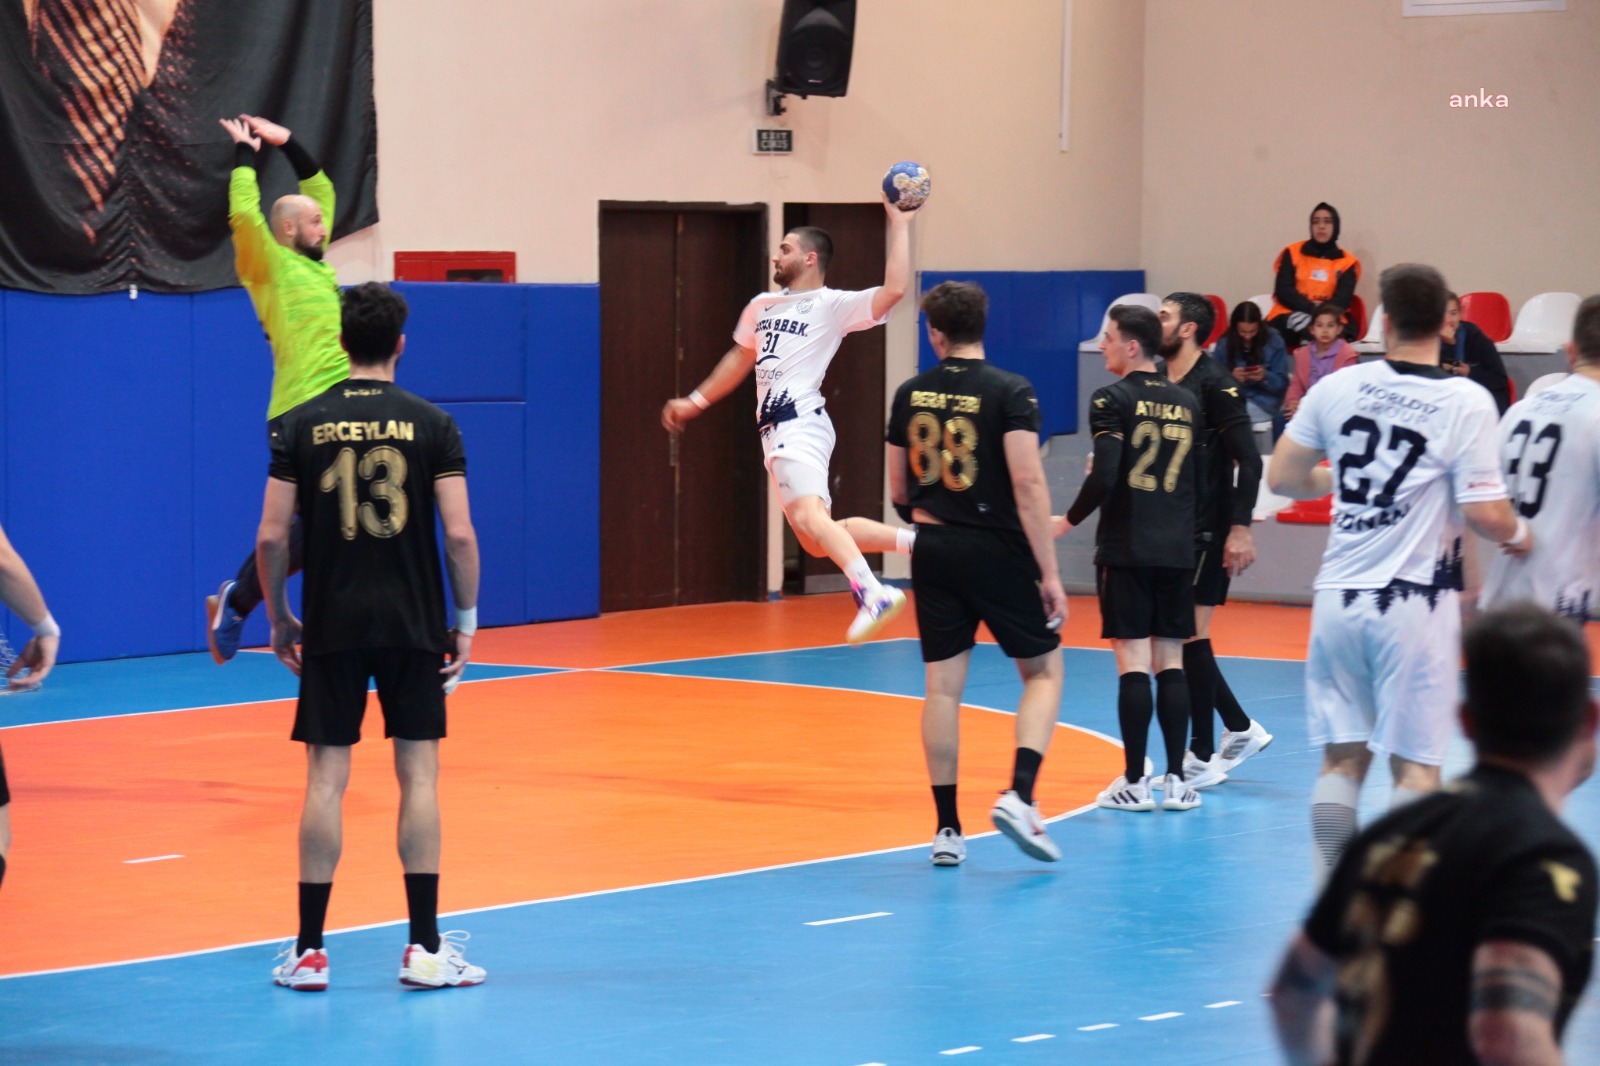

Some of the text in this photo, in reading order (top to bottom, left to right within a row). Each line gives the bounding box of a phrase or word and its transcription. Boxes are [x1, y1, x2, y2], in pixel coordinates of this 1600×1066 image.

[762, 331, 780, 354] 31
[312, 420, 415, 446] ERCEYLAN
[1135, 400, 1193, 423] ATAKAN
[907, 411, 979, 492] 88
[1127, 421, 1193, 493] 27
[1339, 414, 1428, 508] 27
[319, 445, 410, 541] 13
